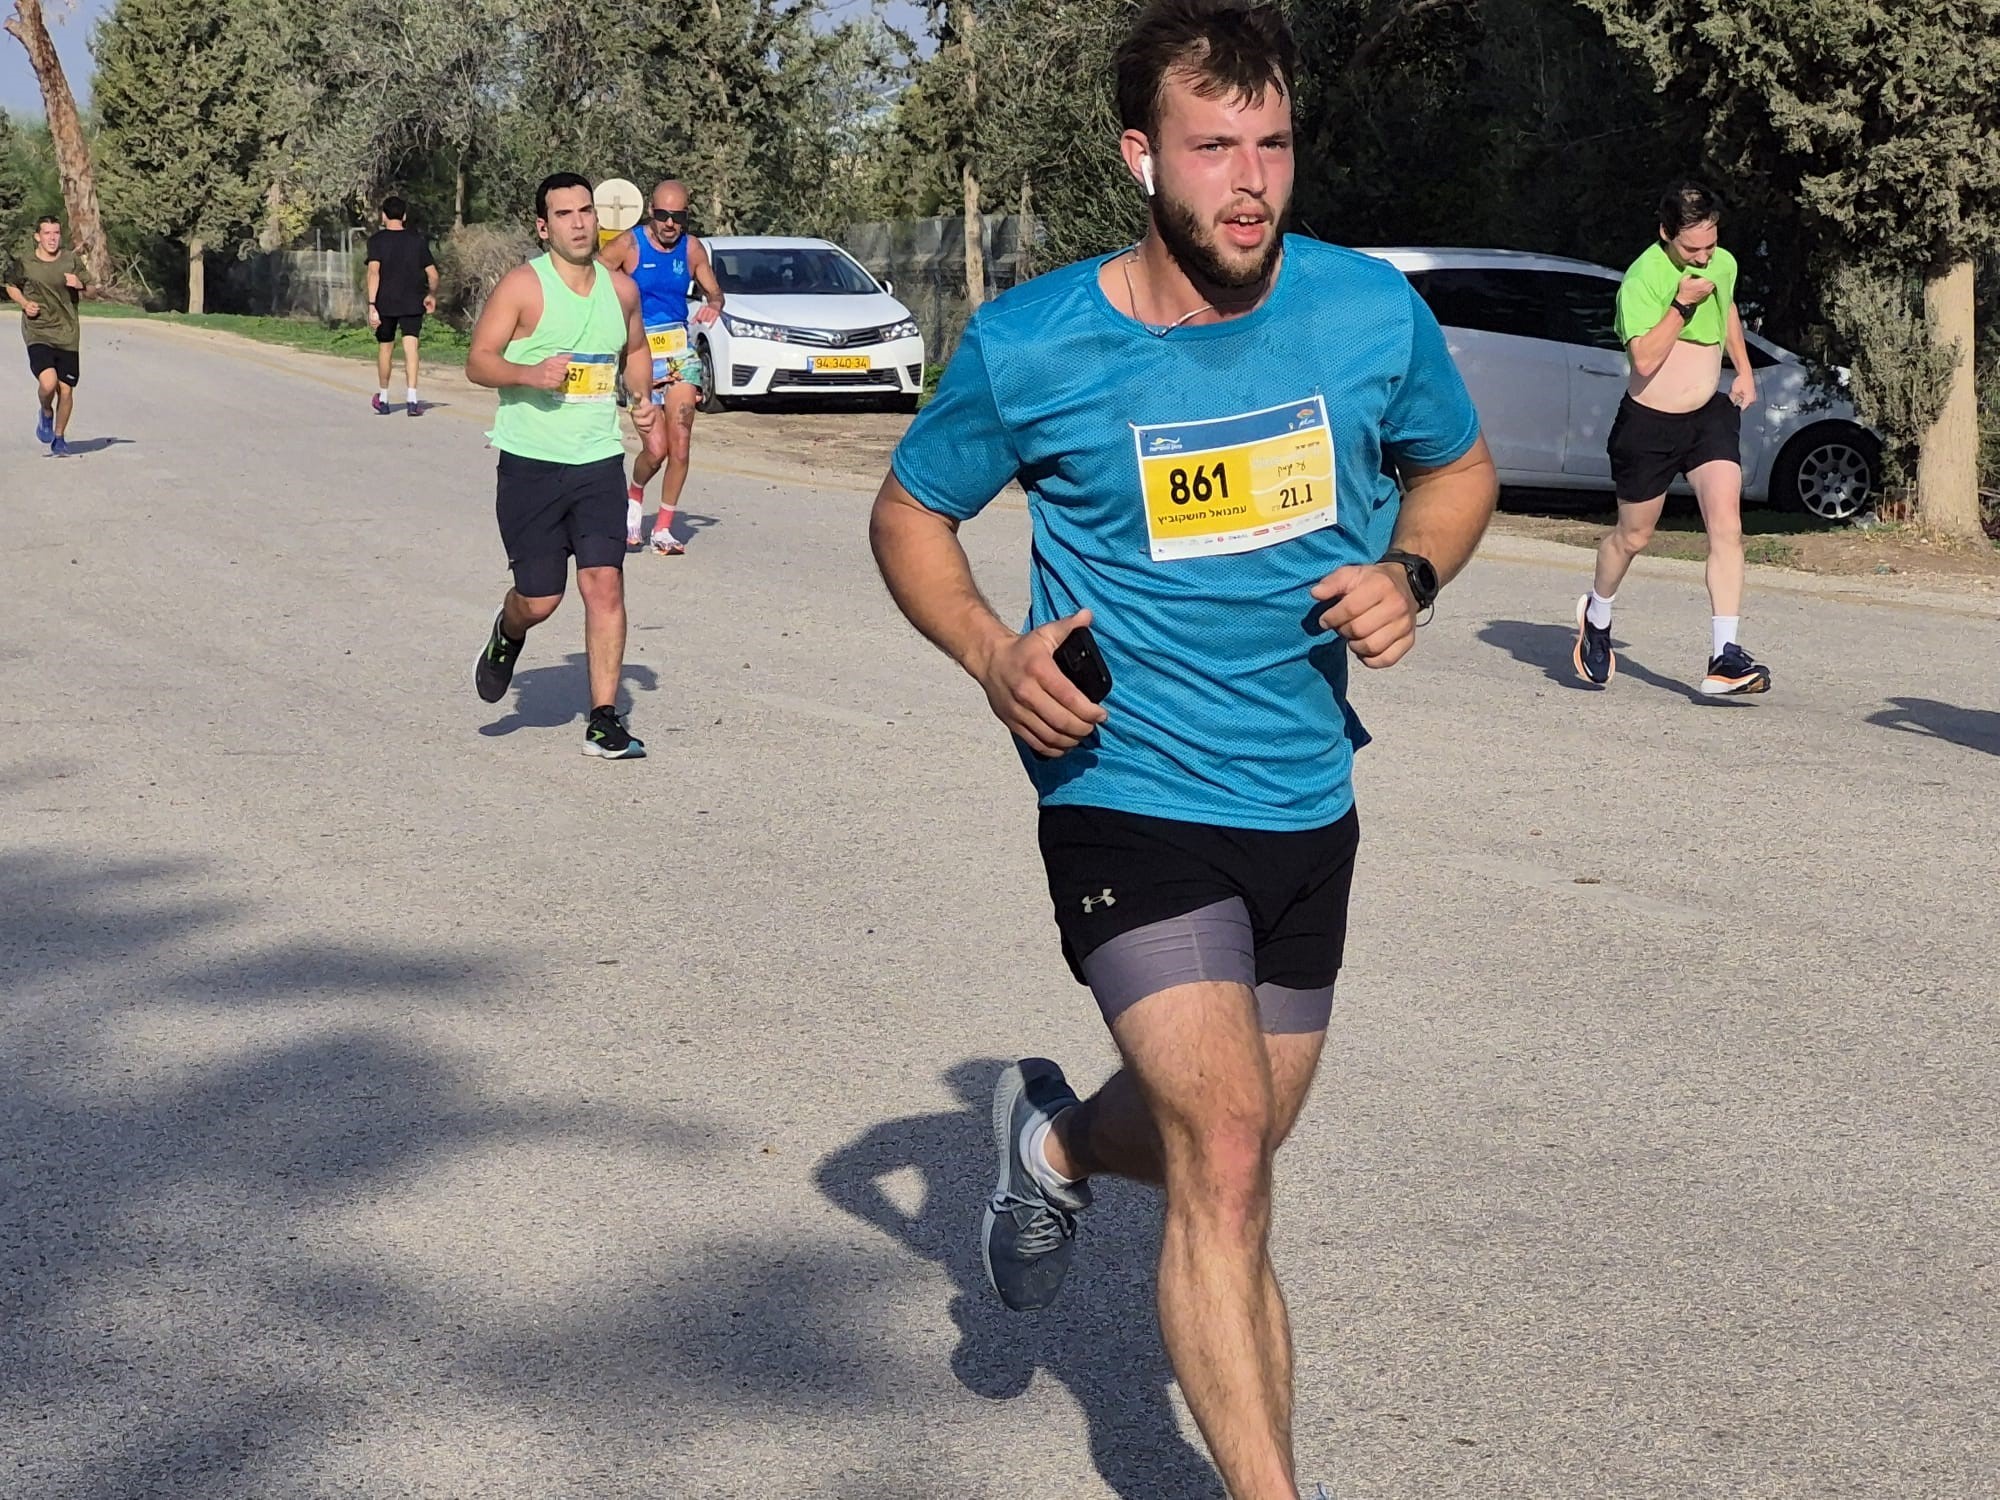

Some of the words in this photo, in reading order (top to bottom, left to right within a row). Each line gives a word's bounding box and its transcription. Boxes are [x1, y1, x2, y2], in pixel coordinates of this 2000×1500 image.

[652, 336, 666, 345] 106
[1169, 461, 1229, 505] 861
[1279, 483, 1313, 509] 21.1
[1157, 511, 1207, 525] מושקוביץ
[1208, 505, 1247, 518] עמנואל
